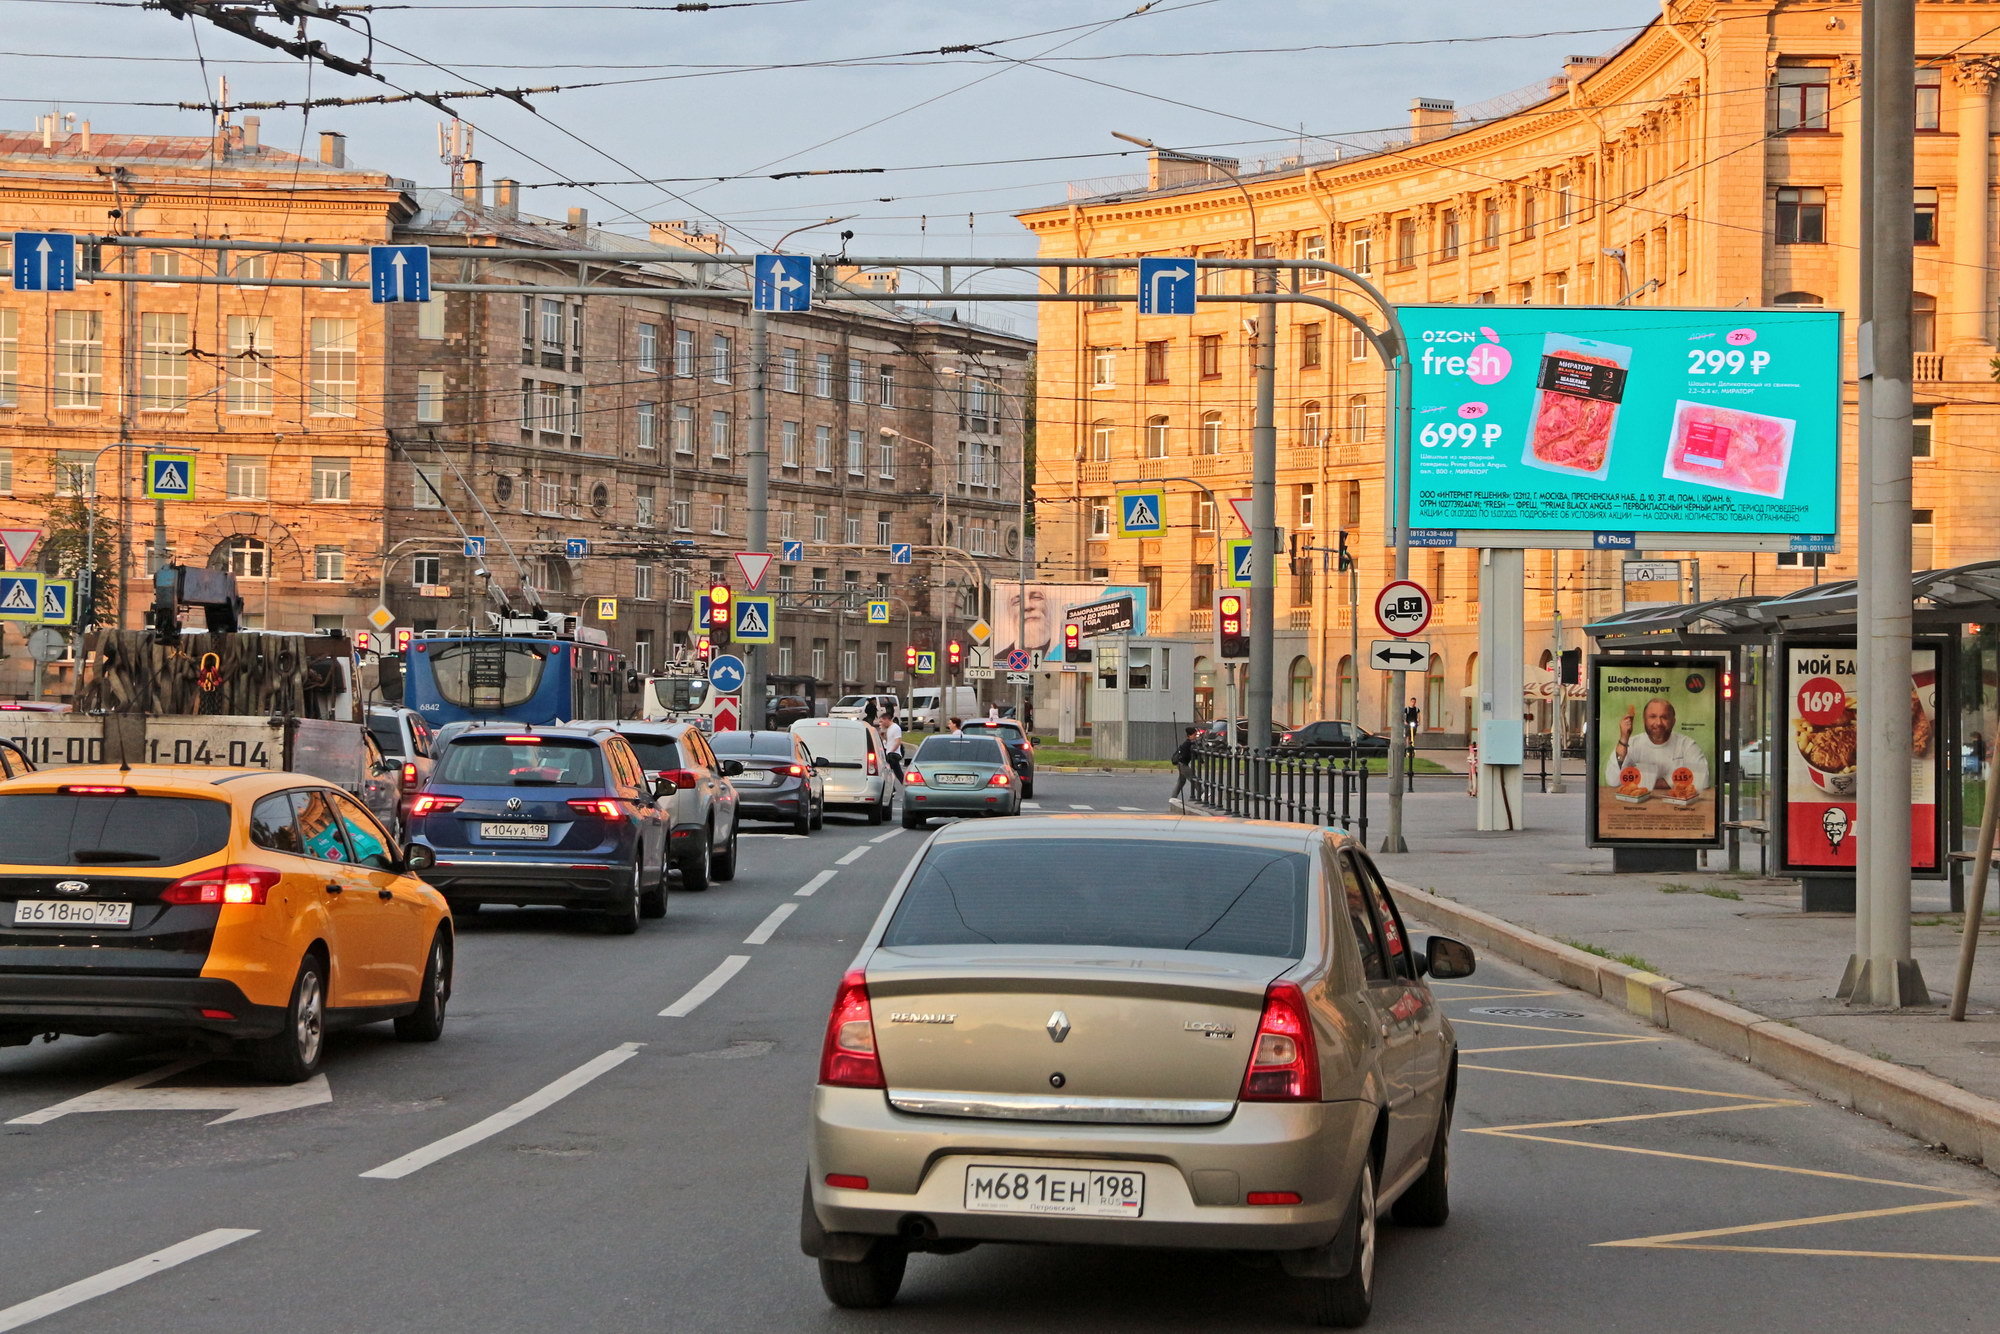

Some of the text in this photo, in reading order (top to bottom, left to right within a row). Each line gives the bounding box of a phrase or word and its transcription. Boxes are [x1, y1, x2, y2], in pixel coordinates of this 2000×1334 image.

[1422, 330, 1476, 343] OZON
[1421, 347, 1500, 376] fresh
[1559, 361, 1593, 372] МИРАТОРГ
[1688, 349, 1771, 375] 299 ₽
[1420, 422, 1503, 448] 699 ₽
[1419, 490, 1436, 498] ООО
[1571, 492, 1620, 500] ПРЕСНЕНСКАЯ
[1419, 499, 1437, 508] ОГРН
[1567, 502, 1588, 510] BLACK
[1589, 502, 1612, 510] ANGUS
[1738, 503, 1765, 513] ПЕРИОД
[1766, 504, 1809, 513] ПРОВЕДЕНИЯ
[1479, 509, 1490, 517] ПО
[1520, 510, 1559, 519] ПОДРОБНЕЕ
[1560, 510, 1570, 519] ОБ
[1571, 511, 1606, 519] УСЛОВИЯХ
[1608, 511, 1632, 520] АКЦИИ
[1643, 512, 1653, 520] НА
[1684, 512, 1729, 521] КОЛИЧЕСТВО
[1730, 513, 1755, 521] ТОВАРА
[1608, 535, 1631, 544] Russ
[1097, 608, 1119, 618] КОНЦА
[1111, 619, 1131, 630] TELE2
[1797, 654, 1857, 675] МОЙ БА
[1608, 676, 1662, 685] Шеф-повар
[1608, 686, 1671, 694] рекомендует
[419, 703, 440, 711] 6842
[144, 739, 269, 768] 1-04-04
[484, 824, 546, 836] К104УА 198
[22, 903, 126, 921] В618НО 797
[891, 1012, 957, 1024] RENAULT
[1184, 1020, 1236, 1032] LOGAN
[975, 1172, 1134, 1203] М681ЕН 198
[1029, 1203, 1076, 1212] Петровский
[1100, 1197, 1122, 1206] RUS
